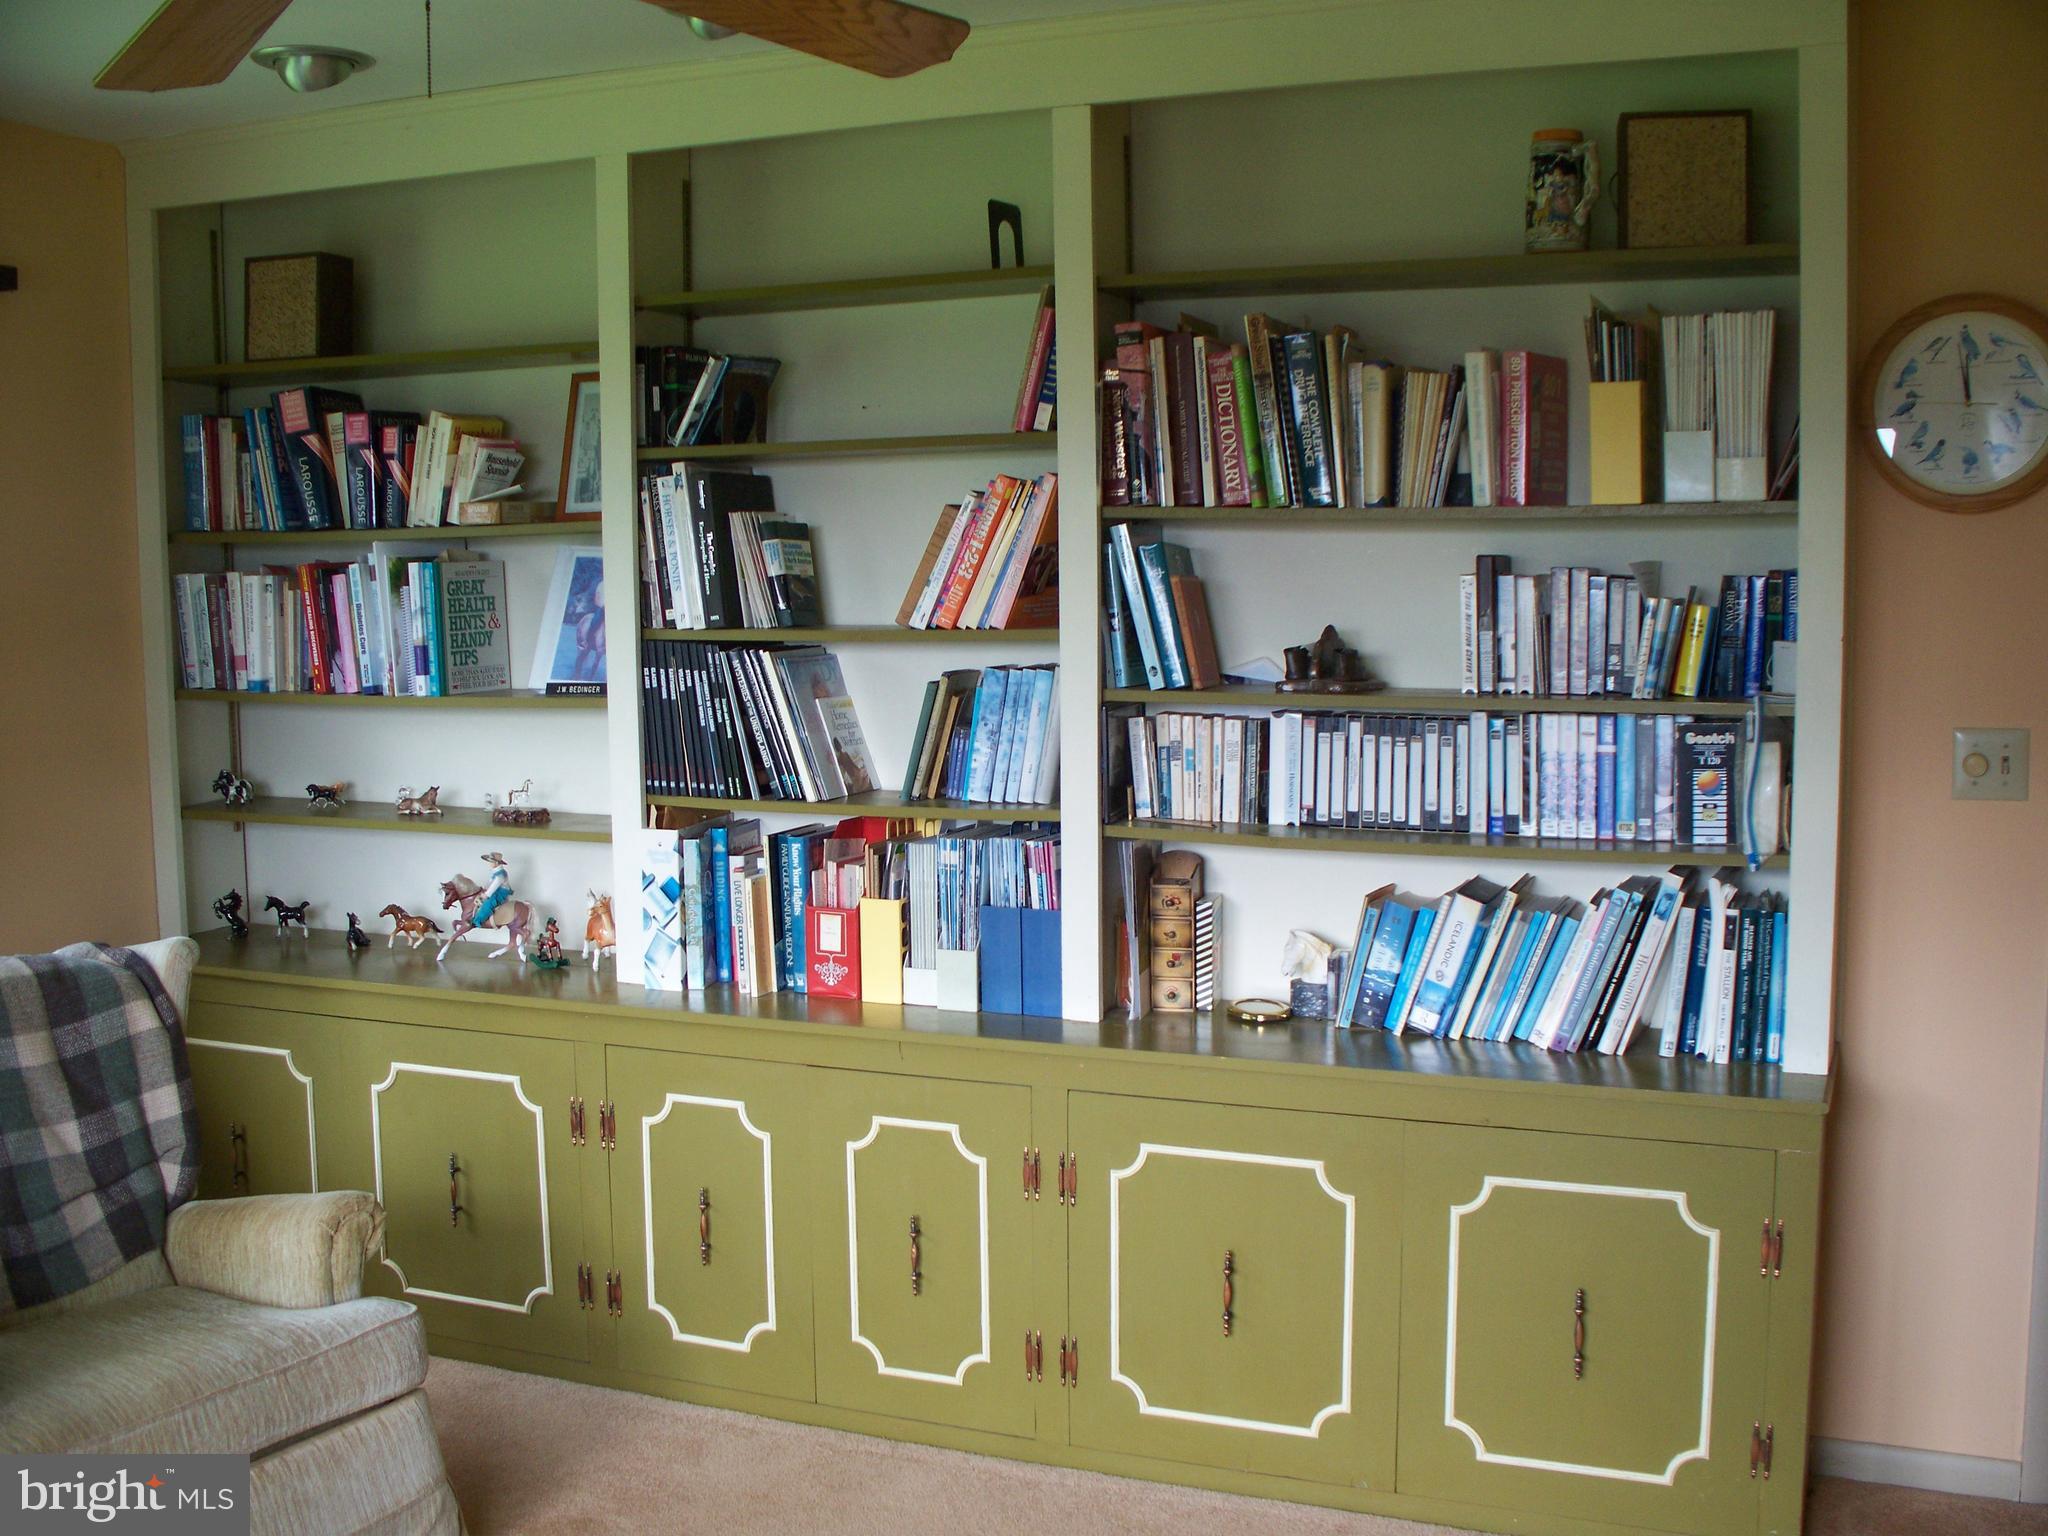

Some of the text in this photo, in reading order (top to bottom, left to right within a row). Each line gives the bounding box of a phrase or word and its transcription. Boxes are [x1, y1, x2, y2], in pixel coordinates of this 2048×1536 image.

[1305, 373, 1316, 396] THE
[1216, 383, 1242, 490] DICTIONARY
[1294, 368, 1315, 468] DRUG REFERENCE
[1511, 381, 1521, 460] PRESCRIPTION
[486, 453, 522, 468] Household
[1114, 420, 1127, 479] Webster's
[299, 457, 319, 523] LAROUSSE
[355, 467, 367, 525] LAROUSSE
[650, 474, 660, 511] HORSES
[1510, 463, 1521, 497] DRUGS
[385, 478, 394, 524] LAROUSSE
[662, 494, 676, 536] HORSES
[670, 552, 683, 592] PONIES
[698, 521, 708, 564] Encyclopedia
[703, 574, 711, 595] Horses
[706, 531, 716, 576] The Complete
[958, 540, 984, 580] 1-2-3
[447, 579, 485, 597] GREAT
[447, 595, 496, 614] HEALTH
[1788, 576, 1799, 614] maxell
[307, 606, 315, 630] HEALING
[355, 603, 367, 655] Diabetes Cure
[448, 612, 501, 632] HINTS &
[1725, 591, 1736, 632] BROWN
[1734, 599, 1745, 623] DAN
[310, 630, 319, 667] DISCOVERIES
[449, 630, 493, 650] HANDY
[1464, 613, 1472, 647] NUTRITION
[451, 649, 479, 667] TIPS
[1464, 649, 1473, 675] CENTER
[569, 686, 601, 694] BEDINGER
[678, 668, 686, 692] VOLCANO
[701, 670, 710, 700] CONTINENTS
[707, 707, 716, 732] COLLISION
[732, 659, 748, 703] MYSTERIES
[749, 715, 771, 769] UNEXPLAINED
[831, 709, 847, 720] Home
[1685, 731, 1735, 744] Scotch
[1707, 756, 1721, 767] 120
[716, 861, 726, 902] BIRDING
[734, 880, 744, 896] LIVE
[791, 843, 804, 915] Know Your Rights
[734, 897, 745, 925] LONGER
[781, 844, 794, 967] FAMILY GUIDE NATURAL MEDICINE
[1438, 920, 1466, 969] ICELANDIC
[1598, 915, 1617, 944] Horse
[1573, 942, 1606, 1001] Conformation
[1722, 966, 1731, 1000] STALLION
